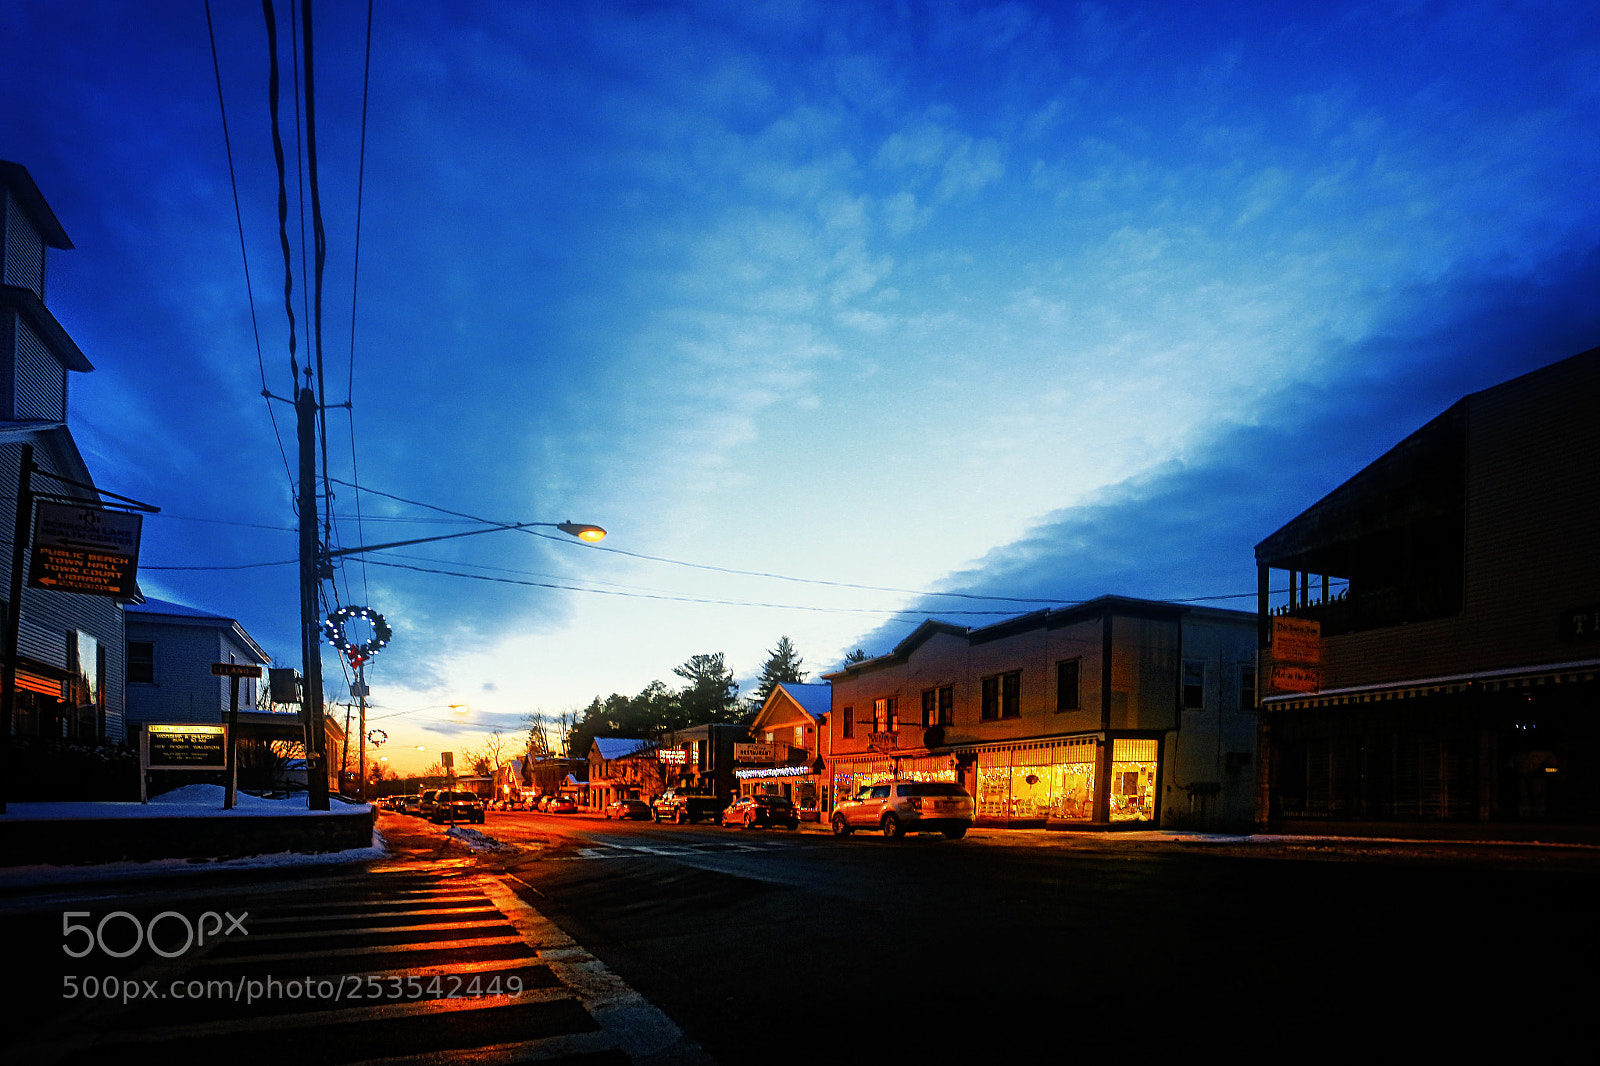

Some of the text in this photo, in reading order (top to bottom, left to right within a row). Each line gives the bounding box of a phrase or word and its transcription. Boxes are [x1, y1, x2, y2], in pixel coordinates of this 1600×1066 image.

[41, 527, 134, 546] HEALTH CENTER
[43, 519, 132, 538] SCHROON LAKE
[40, 547, 129, 565] PUBLIC BEACH
[47, 556, 118, 572] TOWN HALL
[42, 563, 124, 579] TOWN COURT
[57, 572, 110, 585] LIBRARY
